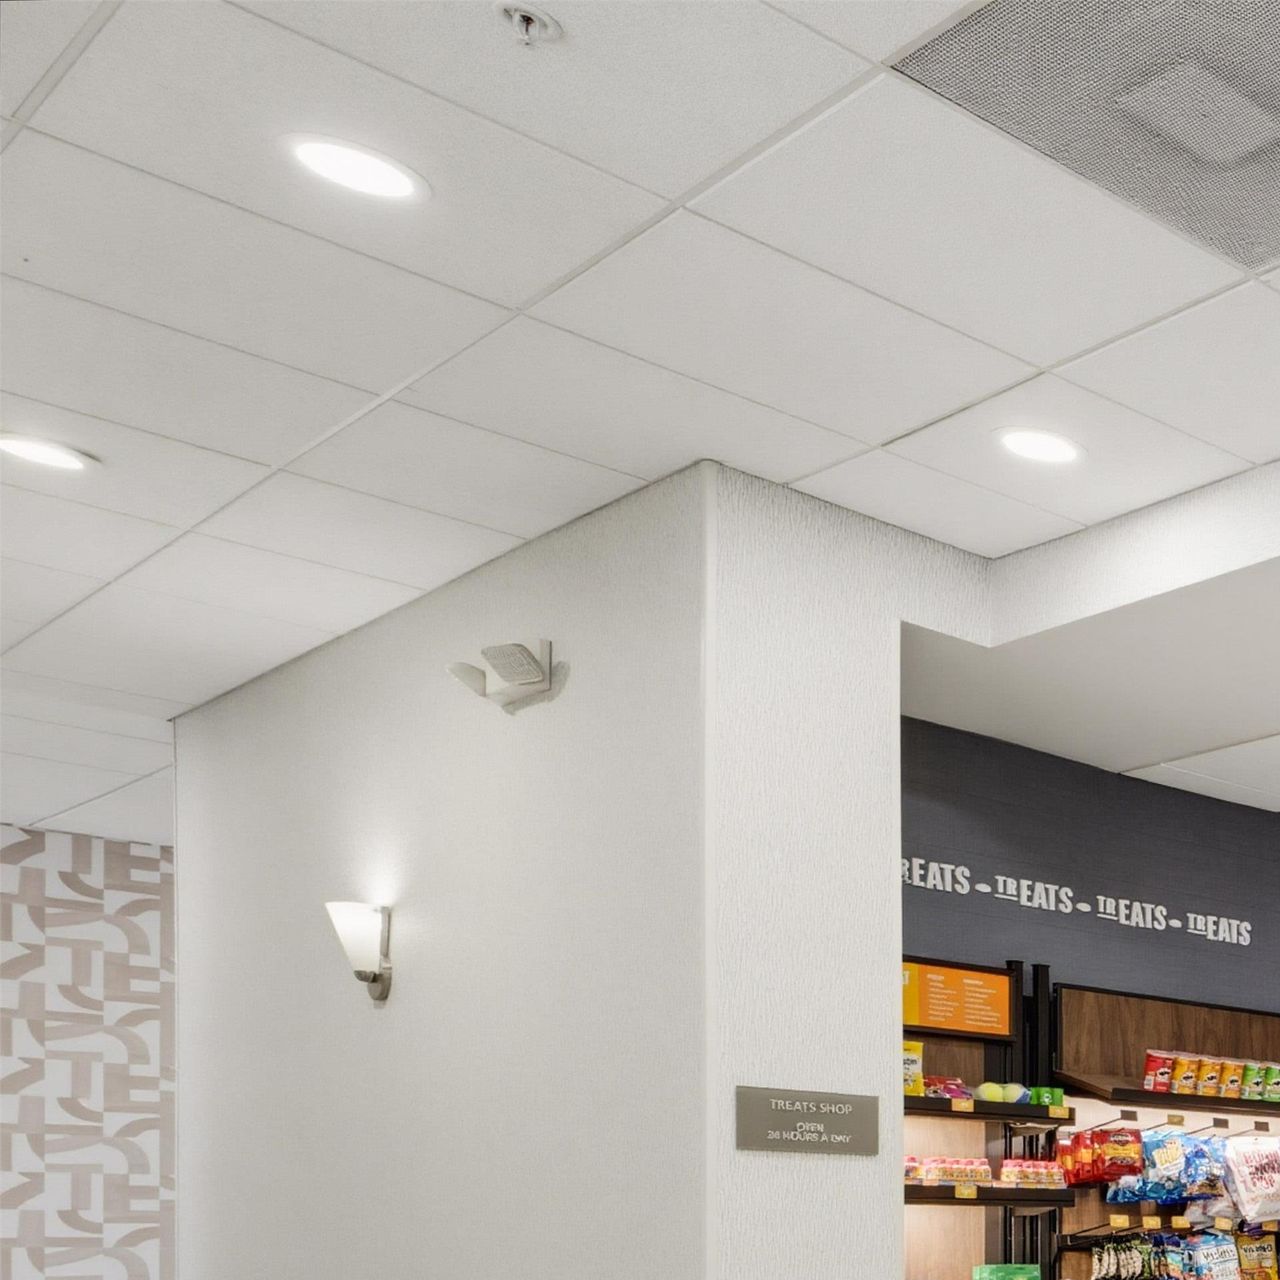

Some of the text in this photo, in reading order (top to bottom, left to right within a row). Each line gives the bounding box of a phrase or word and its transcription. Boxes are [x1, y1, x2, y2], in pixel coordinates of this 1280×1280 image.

[902, 857, 1252, 946] REATS TREATS TREATS TREATS
[769, 1098, 853, 1115] TREATS SHOP
[782, 1131, 818, 1142] HOURS
[819, 1133, 829, 1143] A
